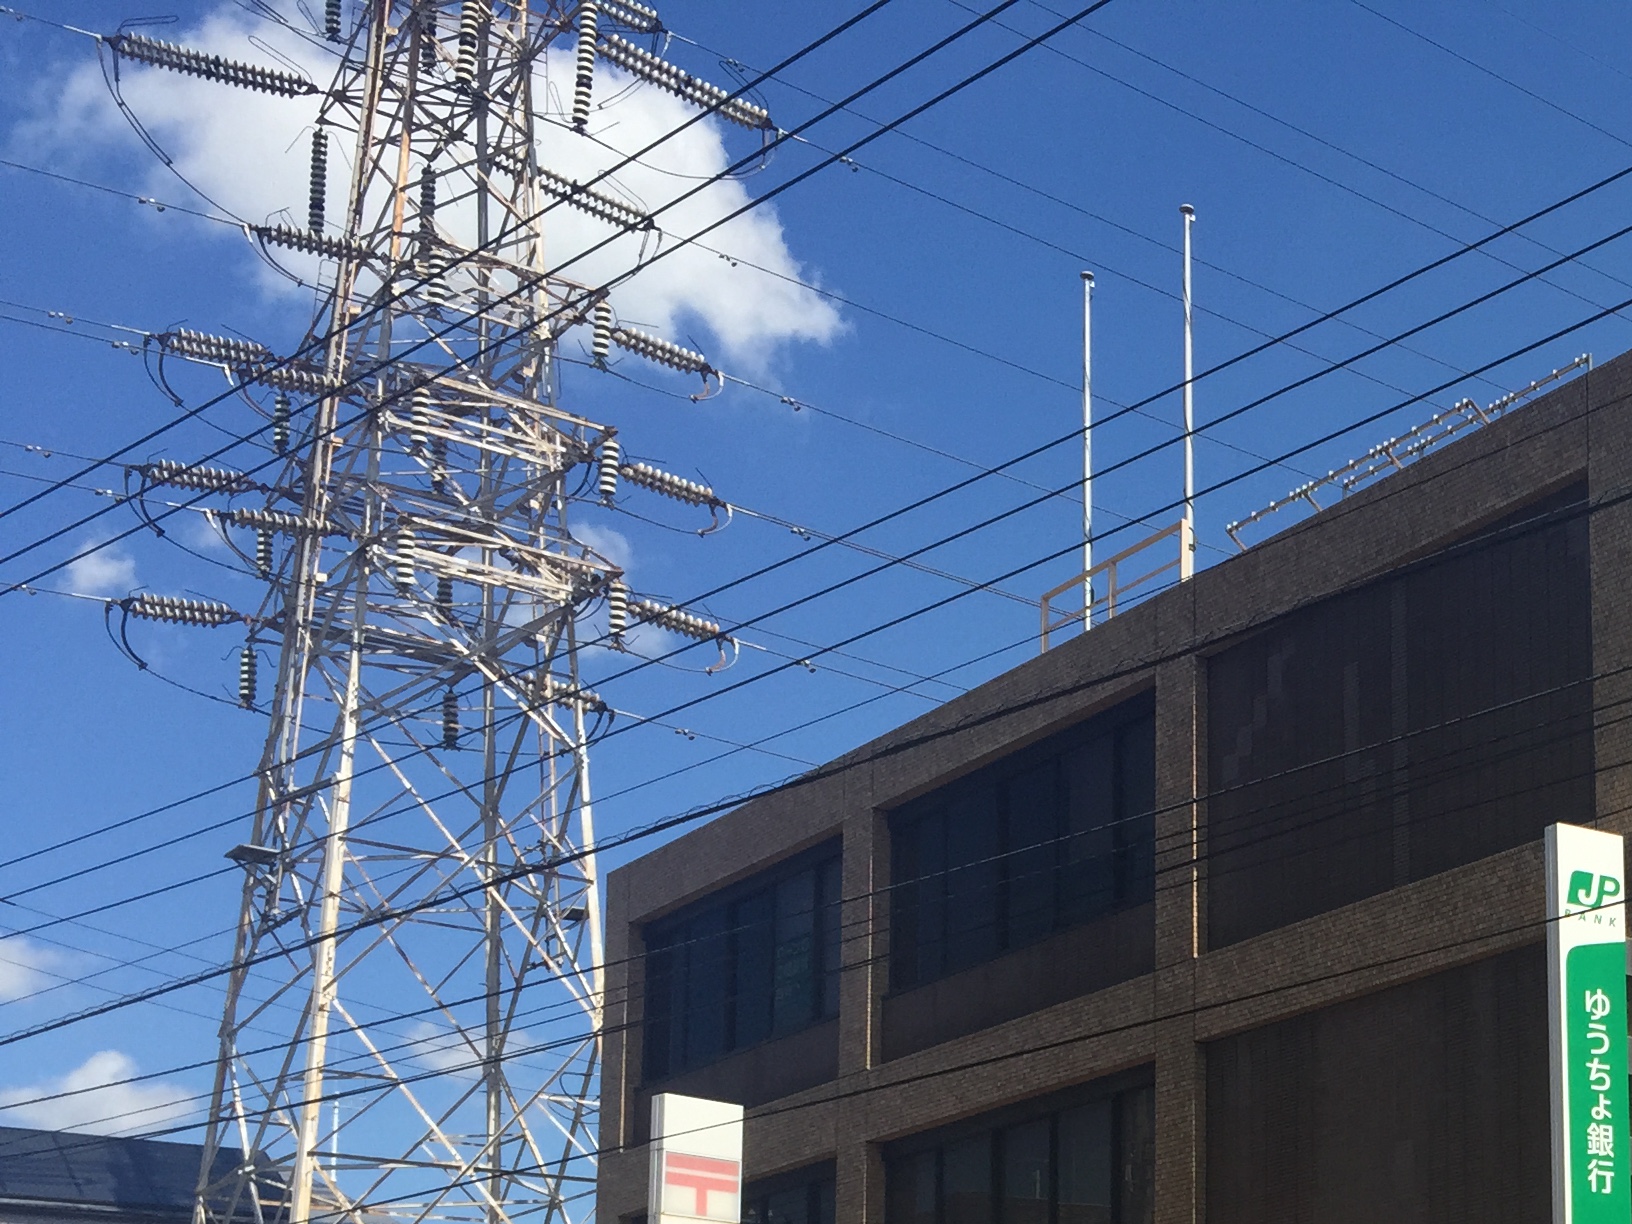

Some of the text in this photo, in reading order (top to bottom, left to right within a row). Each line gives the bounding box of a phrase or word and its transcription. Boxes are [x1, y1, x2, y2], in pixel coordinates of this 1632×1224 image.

[1564, 908, 1616, 927] BANK
[1584, 989, 1615, 1195] ゆうちょ銀行
